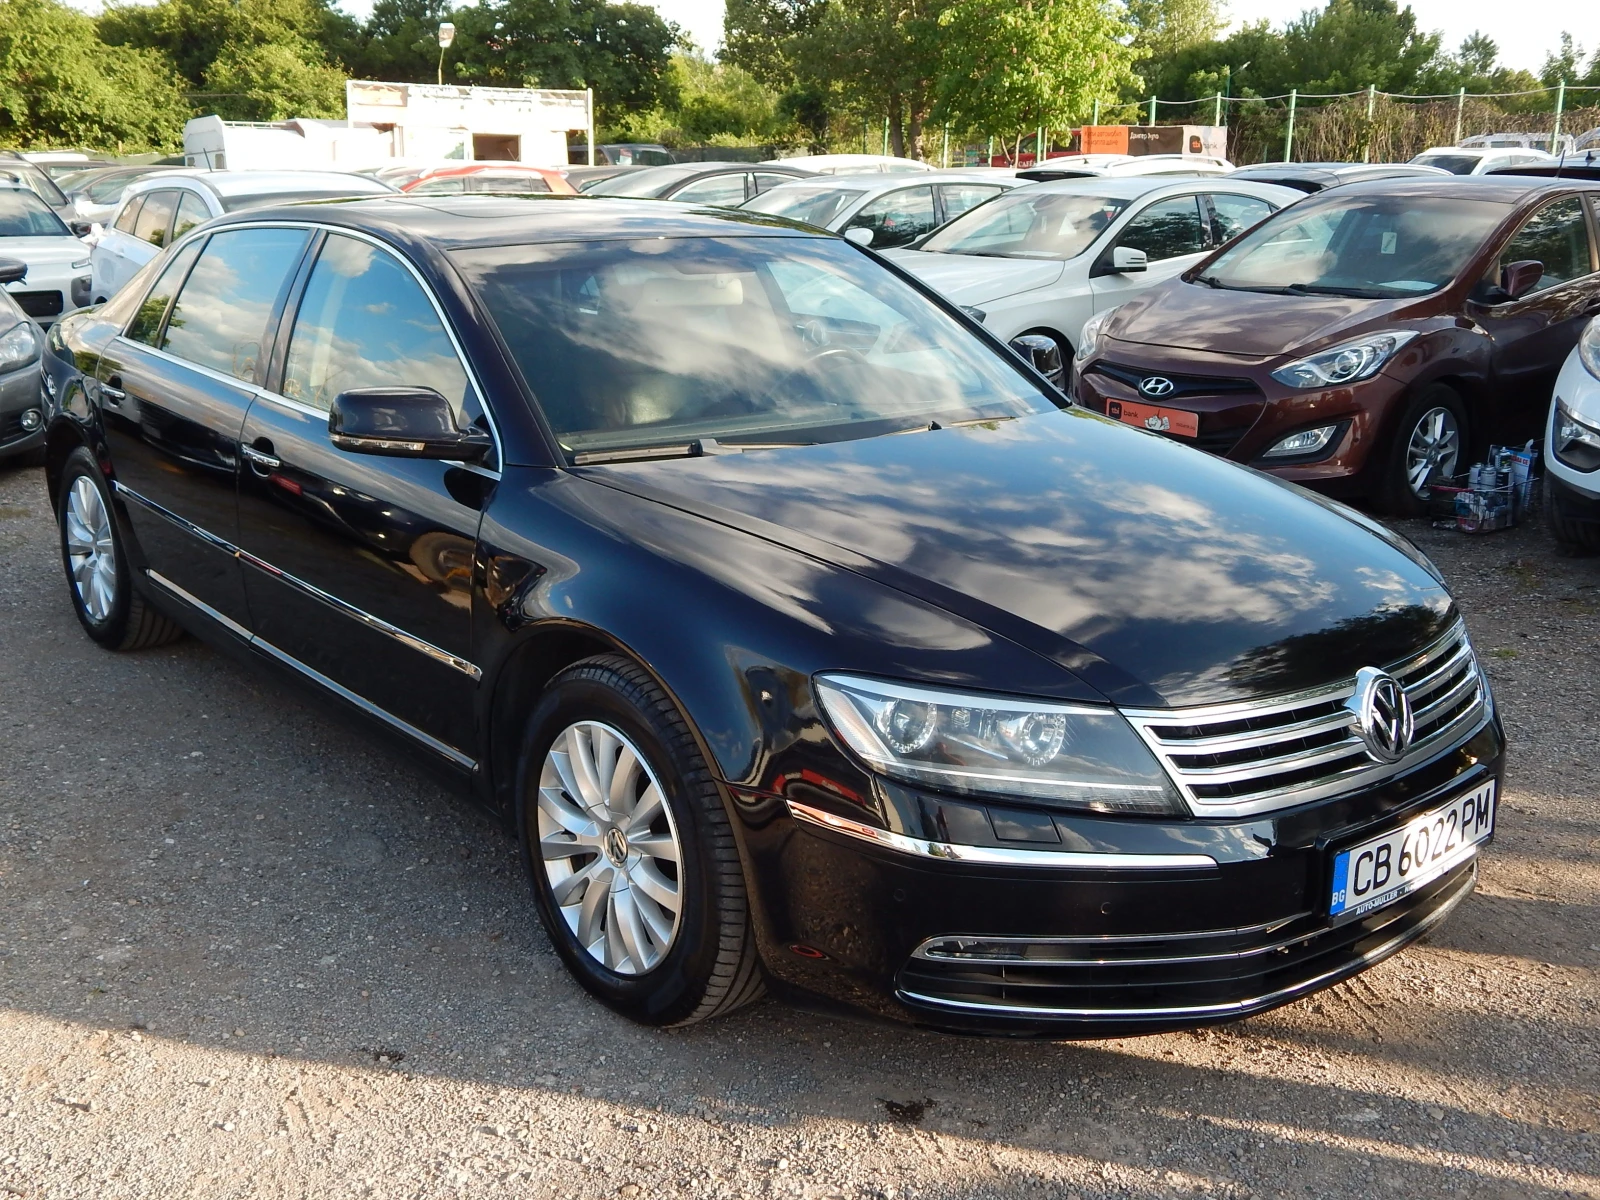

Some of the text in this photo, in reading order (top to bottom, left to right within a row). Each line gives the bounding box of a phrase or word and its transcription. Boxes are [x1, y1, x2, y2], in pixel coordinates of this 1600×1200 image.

[1124, 409, 1138, 418] bank
[1353, 842, 1392, 897] CB
[1398, 808, 1457, 877] 6022
[1461, 787, 1491, 843] PM
[1331, 889, 1345, 906] BG
